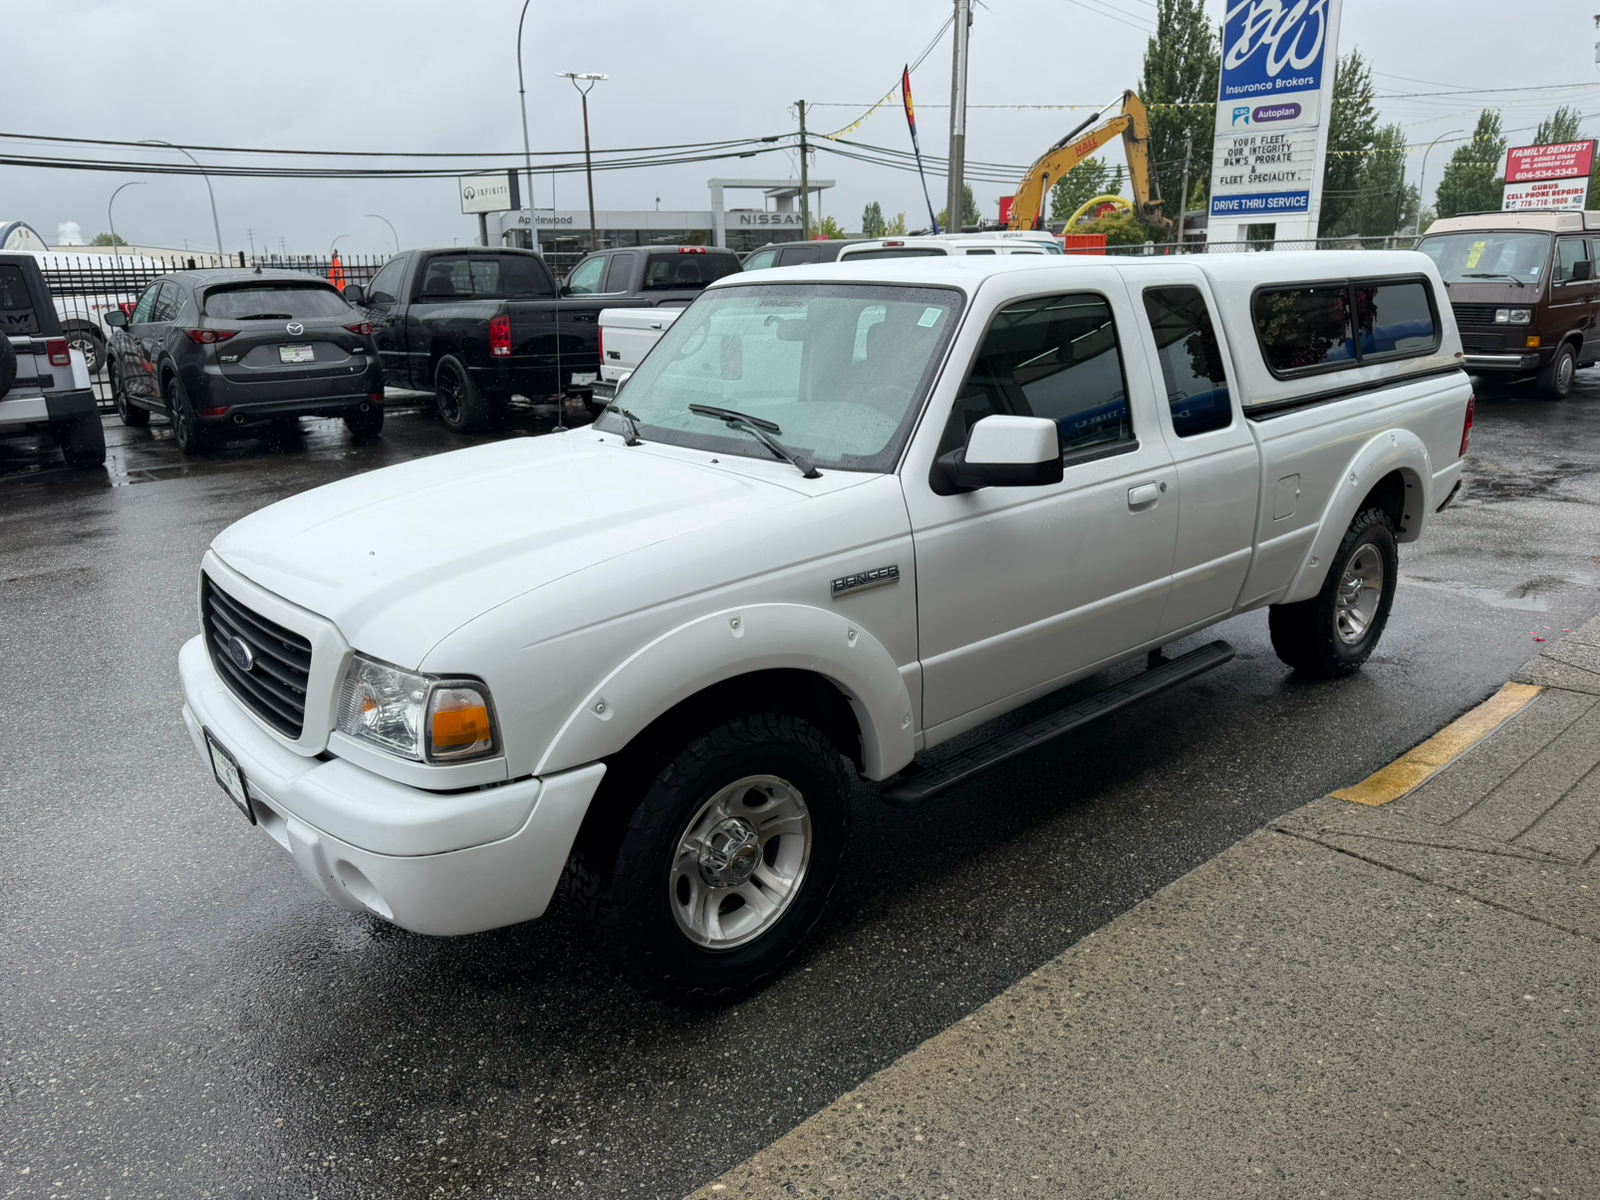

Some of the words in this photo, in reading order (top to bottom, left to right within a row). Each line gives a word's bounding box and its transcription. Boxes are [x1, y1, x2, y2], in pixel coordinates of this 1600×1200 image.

[1226, 80, 1273, 94] Insurance
[1276, 76, 1314, 89] Brokers
[1257, 108, 1295, 119] Autoplan
[1075, 137, 1098, 154] HALL
[1233, 137, 1256, 147] YOUR
[1260, 134, 1289, 145] FLEET.
[1228, 148, 1244, 156] OUR
[1249, 143, 1292, 156] INTEGRITY
[1512, 148, 1545, 158] FAMILY
[1546, 142, 1590, 154] DENTIST
[1224, 156, 1249, 166] B&W'S
[1254, 152, 1292, 164] PRORATE
[1250, 165, 1256, 174] &
[1515, 167, 1578, 180] 604-534-3343
[1220, 175, 1244, 185] FLEET
[1248, 172, 1301, 183] SPECIALITY.
[477, 186, 507, 196] INFINITI
[1525, 190, 1550, 198] PHONE
[1552, 188, 1584, 196] REPAIRS
[1214, 200, 1240, 210] DRIVE
[1240, 198, 1266, 210] THRU
[1267, 196, 1307, 208] SERVICE
[740, 214, 803, 224] NISSAN
[832, 564, 899, 592] RANGER
